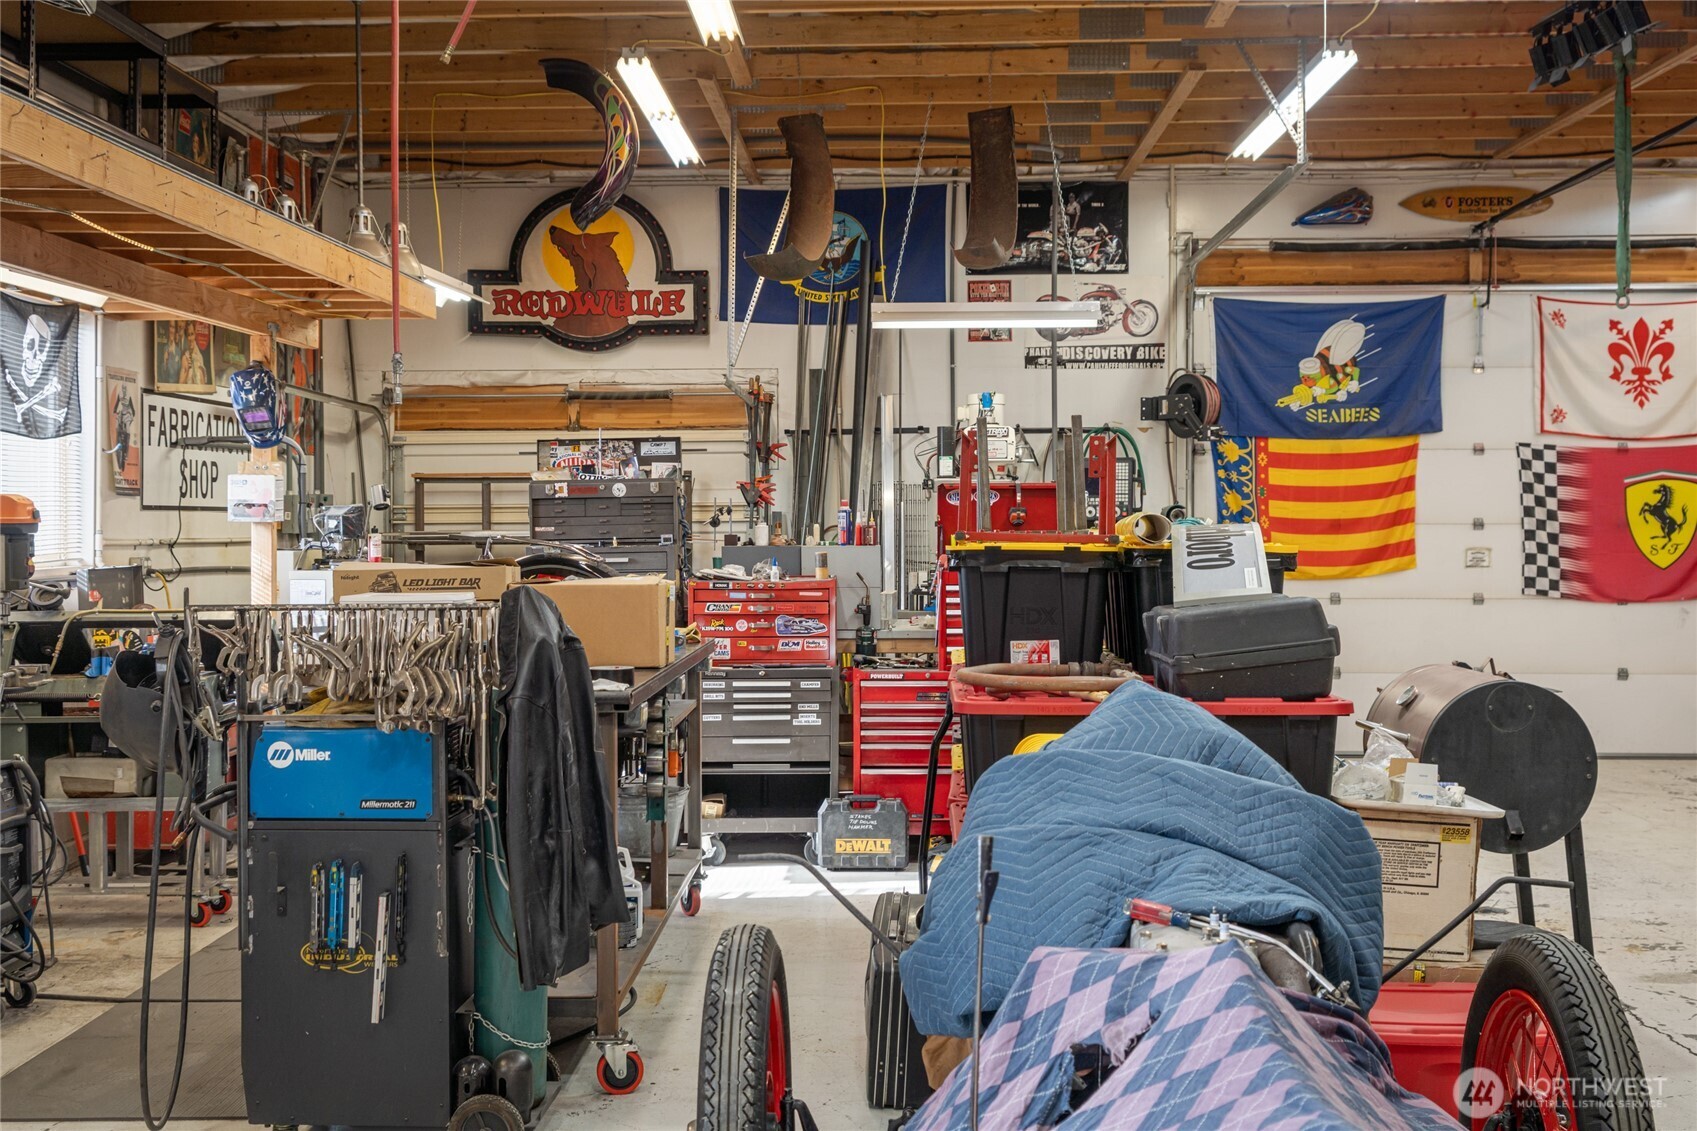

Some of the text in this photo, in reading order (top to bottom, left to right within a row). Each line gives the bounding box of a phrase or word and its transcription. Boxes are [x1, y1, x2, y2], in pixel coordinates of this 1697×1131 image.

[1458, 197, 1514, 207] FOSTER'S
[1024, 347, 1063, 356] PHANTM
[1063, 346, 1133, 360] DISCOVERY
[1305, 407, 1380, 424] SEABEES
[180, 458, 219, 498] SHOP
[402, 578, 482, 590] LED LIGHT BAR
[295, 749, 330, 761] Miller
[361, 800, 403, 809] Millermatic
